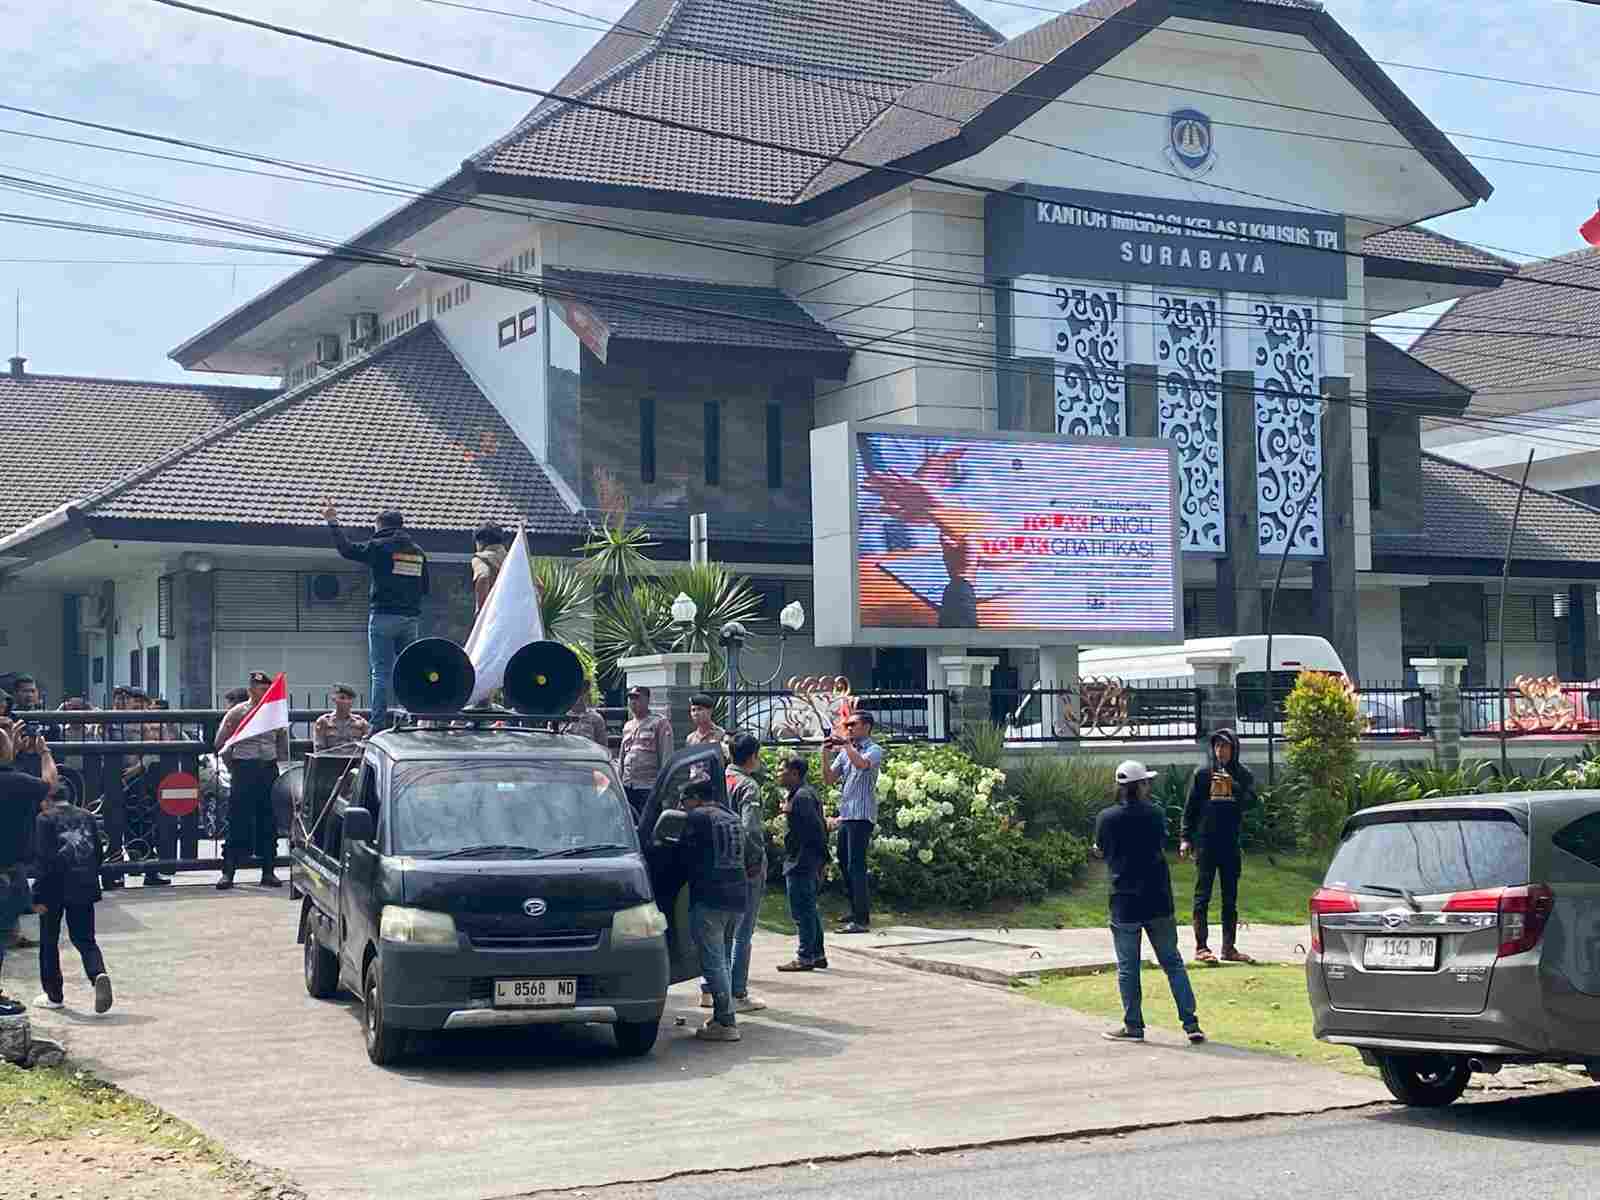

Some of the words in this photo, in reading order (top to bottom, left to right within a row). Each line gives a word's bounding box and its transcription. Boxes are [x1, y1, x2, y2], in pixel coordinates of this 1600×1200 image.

[1037, 202, 1107, 228] KANTOR
[1185, 216, 1237, 241] KELAS
[1314, 229, 1338, 250] TPI
[1120, 241, 1265, 274] SURABAYA
[497, 983, 506, 997] L
[558, 981, 574, 996] ND
